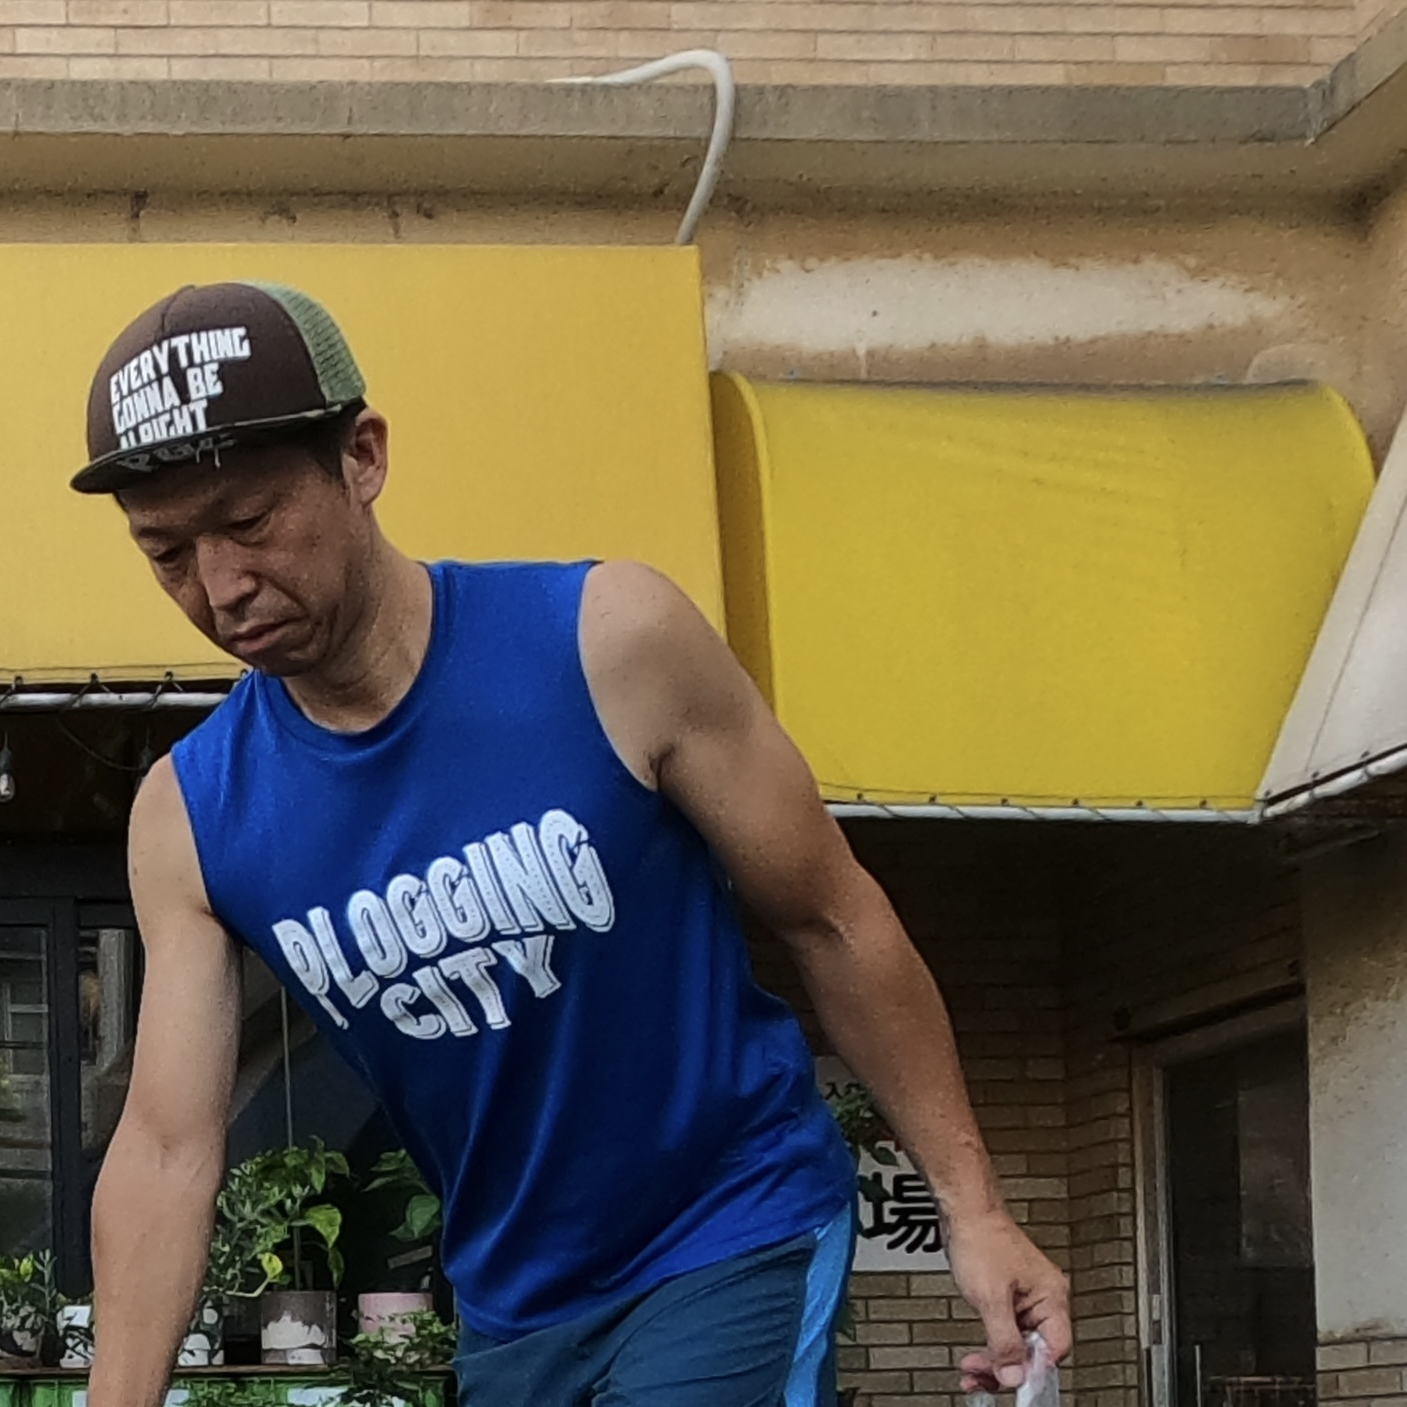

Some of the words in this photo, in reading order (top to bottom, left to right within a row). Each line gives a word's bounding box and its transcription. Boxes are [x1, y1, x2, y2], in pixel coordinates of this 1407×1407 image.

[110, 326, 252, 404] EVERYTHING
[113, 376, 181, 434] GONNA
[186, 363, 223, 400] BE
[272, 809, 615, 1030] PLOGGING
[379, 934, 561, 1040] CITY
